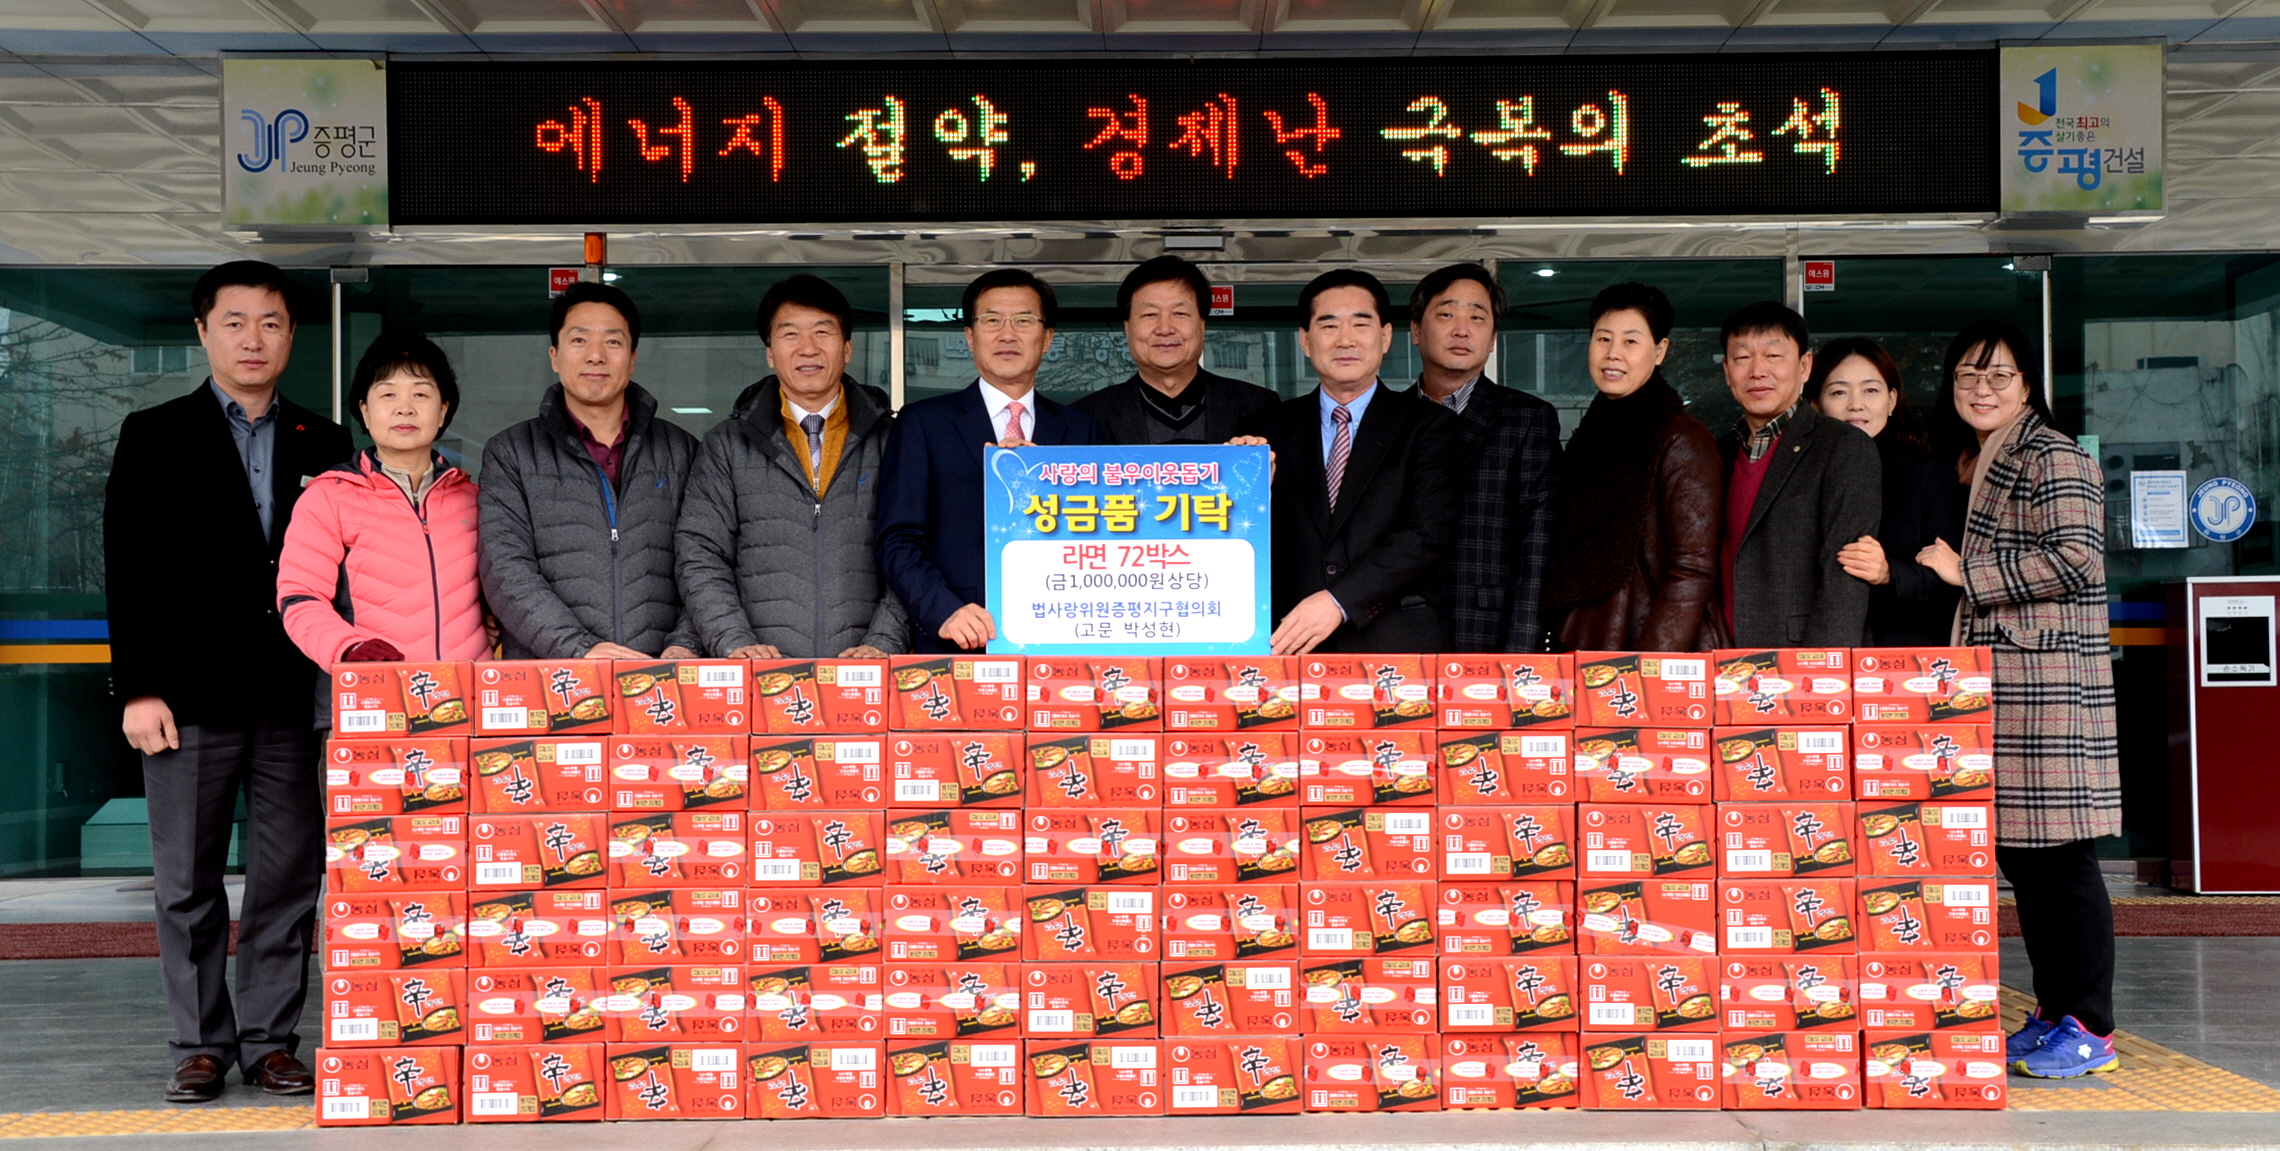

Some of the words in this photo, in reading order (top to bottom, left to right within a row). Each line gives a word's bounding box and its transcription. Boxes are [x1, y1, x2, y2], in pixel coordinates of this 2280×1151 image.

[313, 125, 376, 158] 증평군
[536, 97, 783, 183] 에너지
[836, 94, 1035, 183] 절약,
[1083, 92, 1342, 180] 경제난
[1380, 90, 1628, 177] 극복의
[1680, 87, 1839, 175] 초석
[290, 162, 326, 176] Jeung
[330, 162, 376, 176] Pyeong
[1808, 268, 1829, 278] 에스원
[1039, 462, 1097, 484] 사랑의
[1103, 462, 1219, 484] 불우이웃돕기
[2197, 481, 2219, 498] JEUNG
[2222, 480, 2249, 498] PYEONG
[1023, 494, 1140, 532] 성금품
[1154, 493, 1233, 532] 기탁
[1063, 544, 1107, 570] 라면
[1118, 544, 1191, 569] 72박스
[1032, 601, 1222, 619] 법사랑위원증평지구협의회
[1074, 622, 1113, 639] (고문
[1124, 622, 1181, 639] 박성현)
